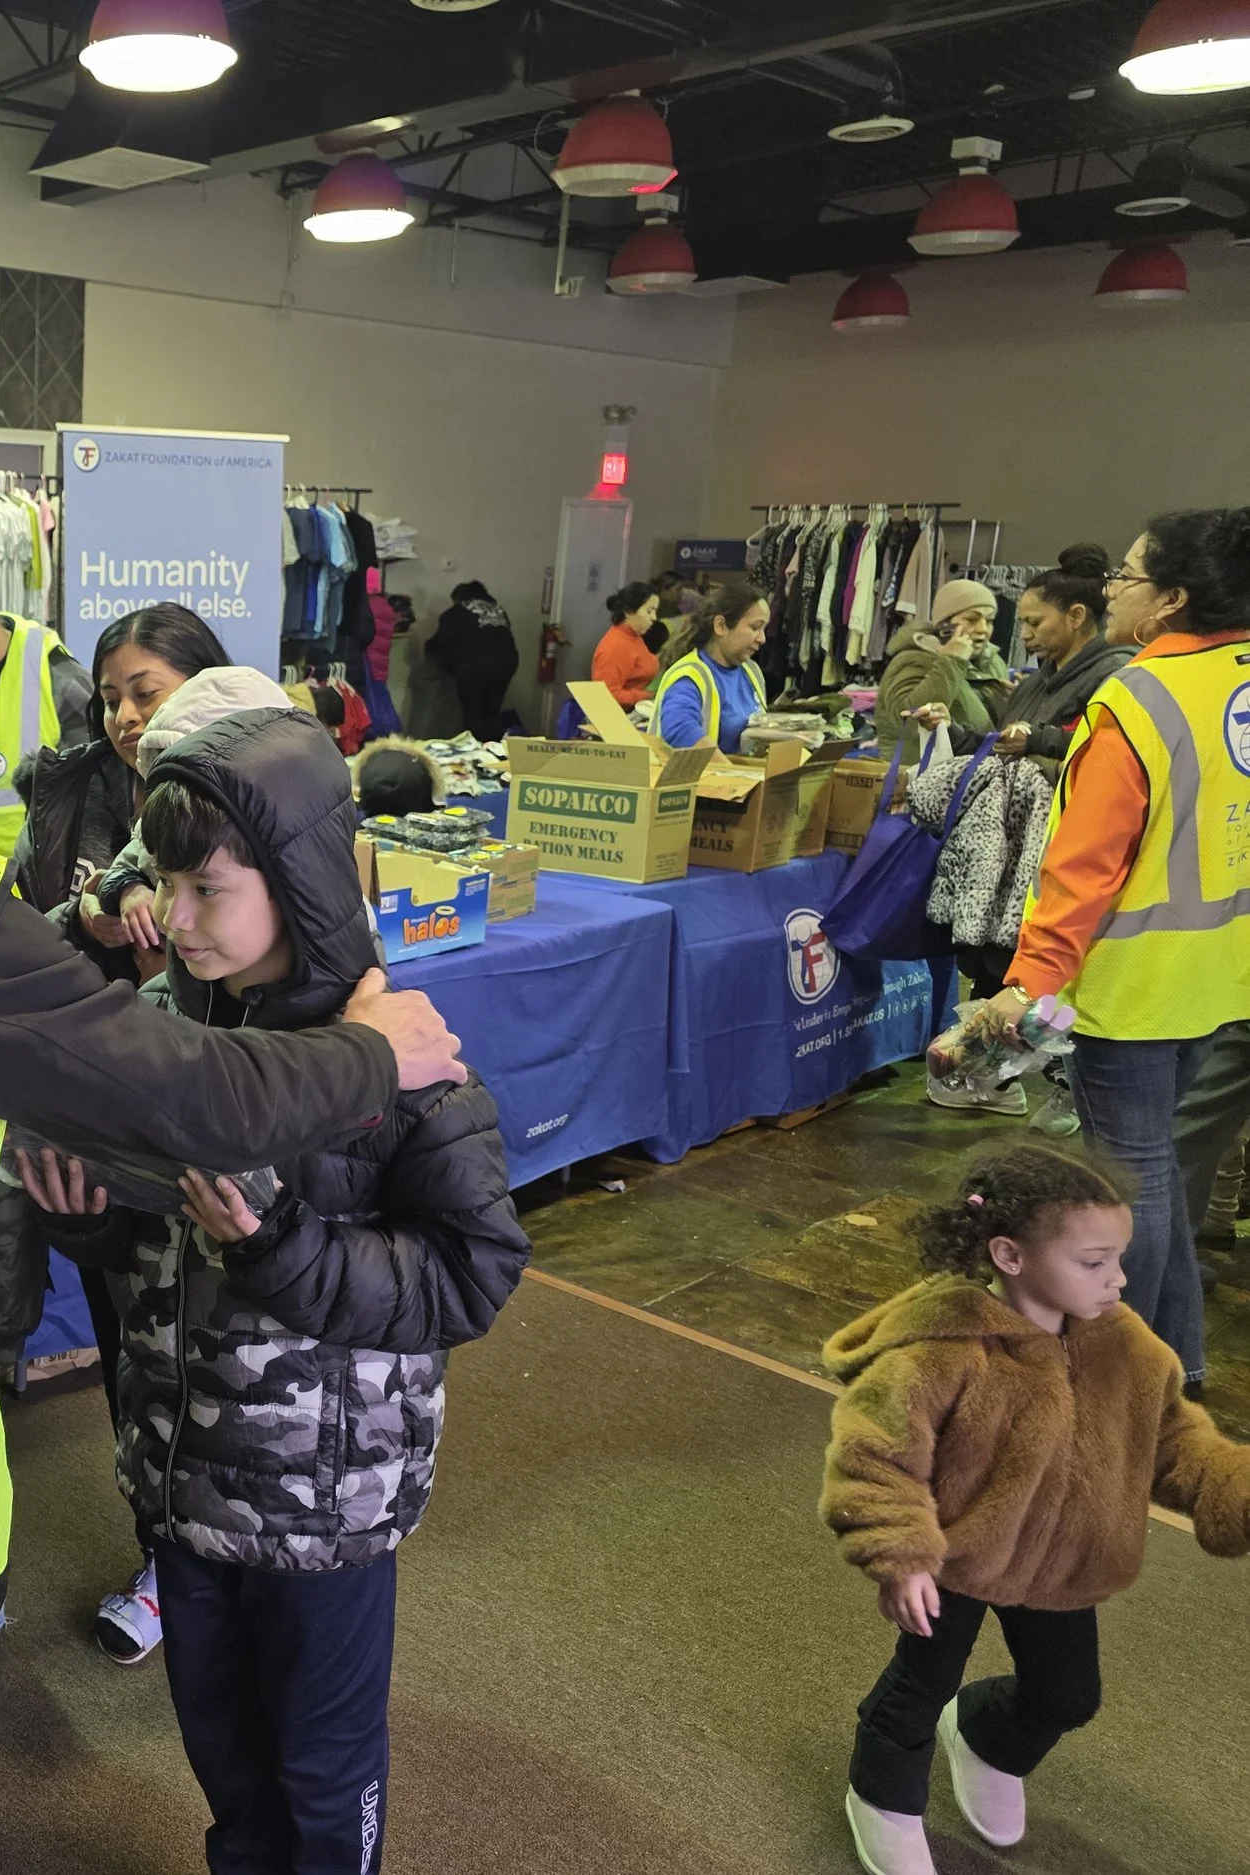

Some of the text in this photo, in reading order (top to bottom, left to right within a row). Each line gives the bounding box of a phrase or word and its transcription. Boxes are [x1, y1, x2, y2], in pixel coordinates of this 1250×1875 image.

[104, 451, 272, 469] ZAKAT FOUNDATION of AMERICA
[80, 550, 249, 595] Humanity
[197, 591, 252, 618] else.
[524, 785, 631, 816] SOPAKCO
[529, 821, 618, 845] EMERGENCY
[578, 847, 623, 864] MEALS
[404, 911, 460, 945] halos
